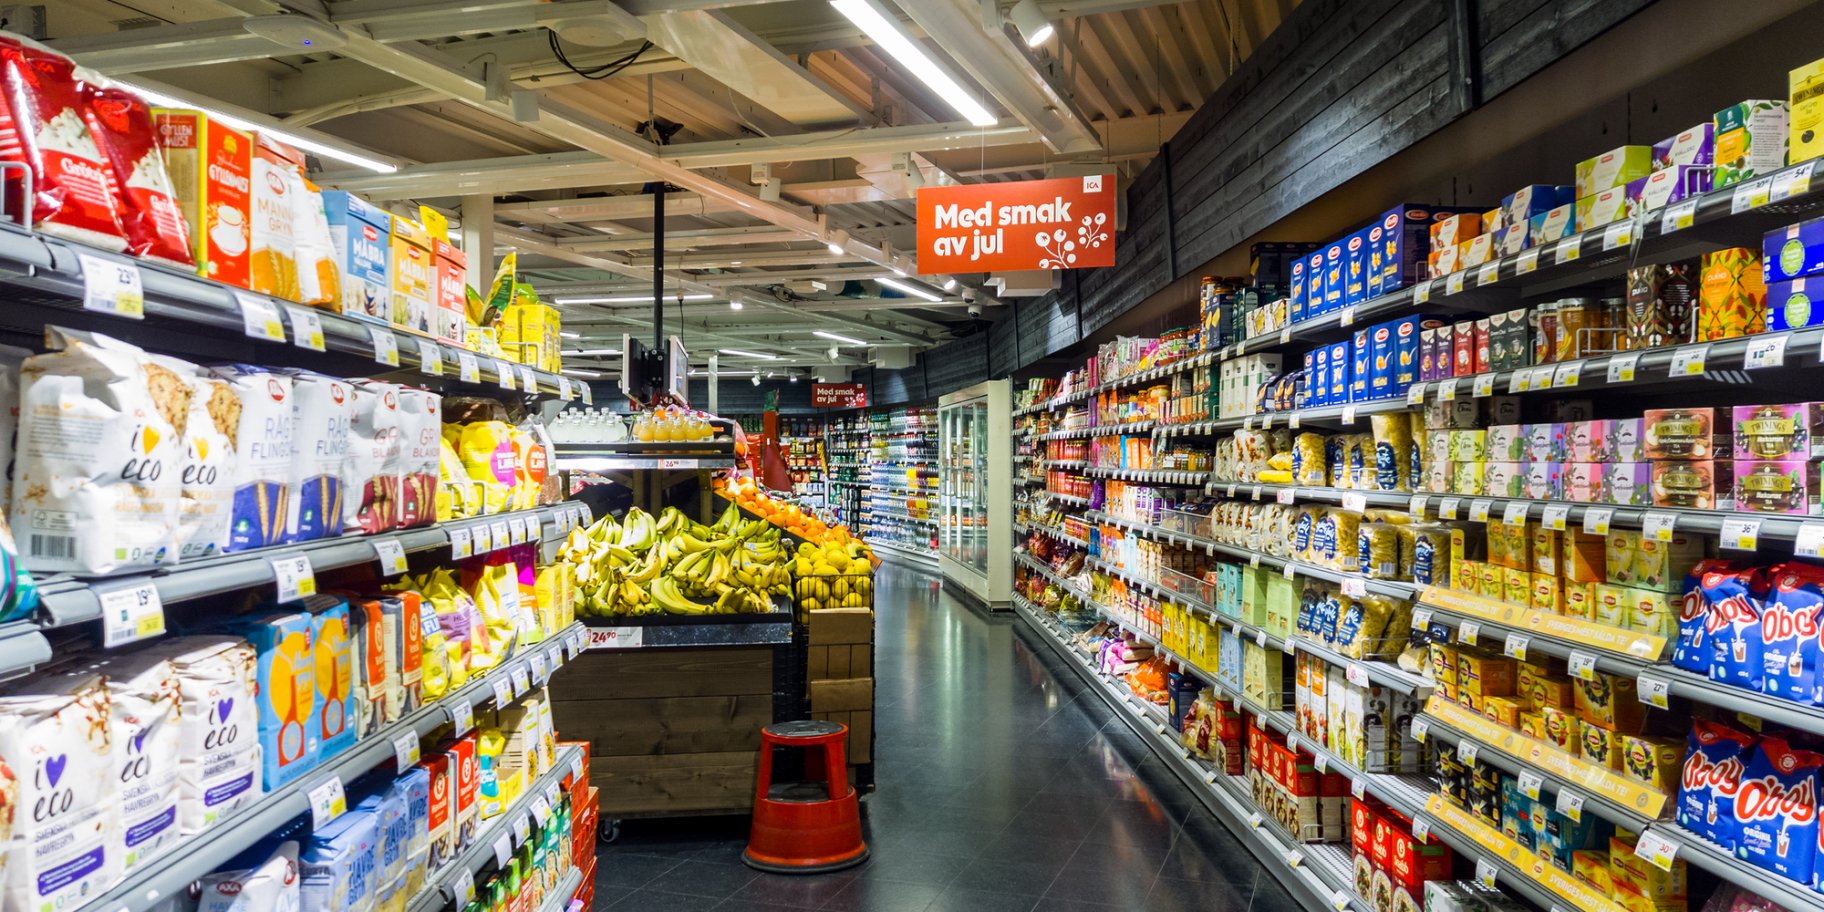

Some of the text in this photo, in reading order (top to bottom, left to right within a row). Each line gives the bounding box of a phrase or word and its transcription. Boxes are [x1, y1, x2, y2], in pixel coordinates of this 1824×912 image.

[1086, 181, 1099, 190] ICA
[935, 196, 1072, 229] Med smak
[933, 228, 1004, 261] av jul
[827, 395, 837, 404] jul
[835, 388, 855, 396] smak
[1661, 424, 1694, 433] TWININGS
[1751, 420, 1787, 433] TWININGS
[121, 458, 162, 481] eco
[182, 464, 217, 485] eco
[1751, 477, 1785, 489] TWININGS
[1762, 601, 1824, 645] O'boy
[204, 724, 238, 750] eco
[33, 788, 73, 822] eco
[1734, 775, 1817, 825] O'boy
[219, 883, 240, 892] AXA
